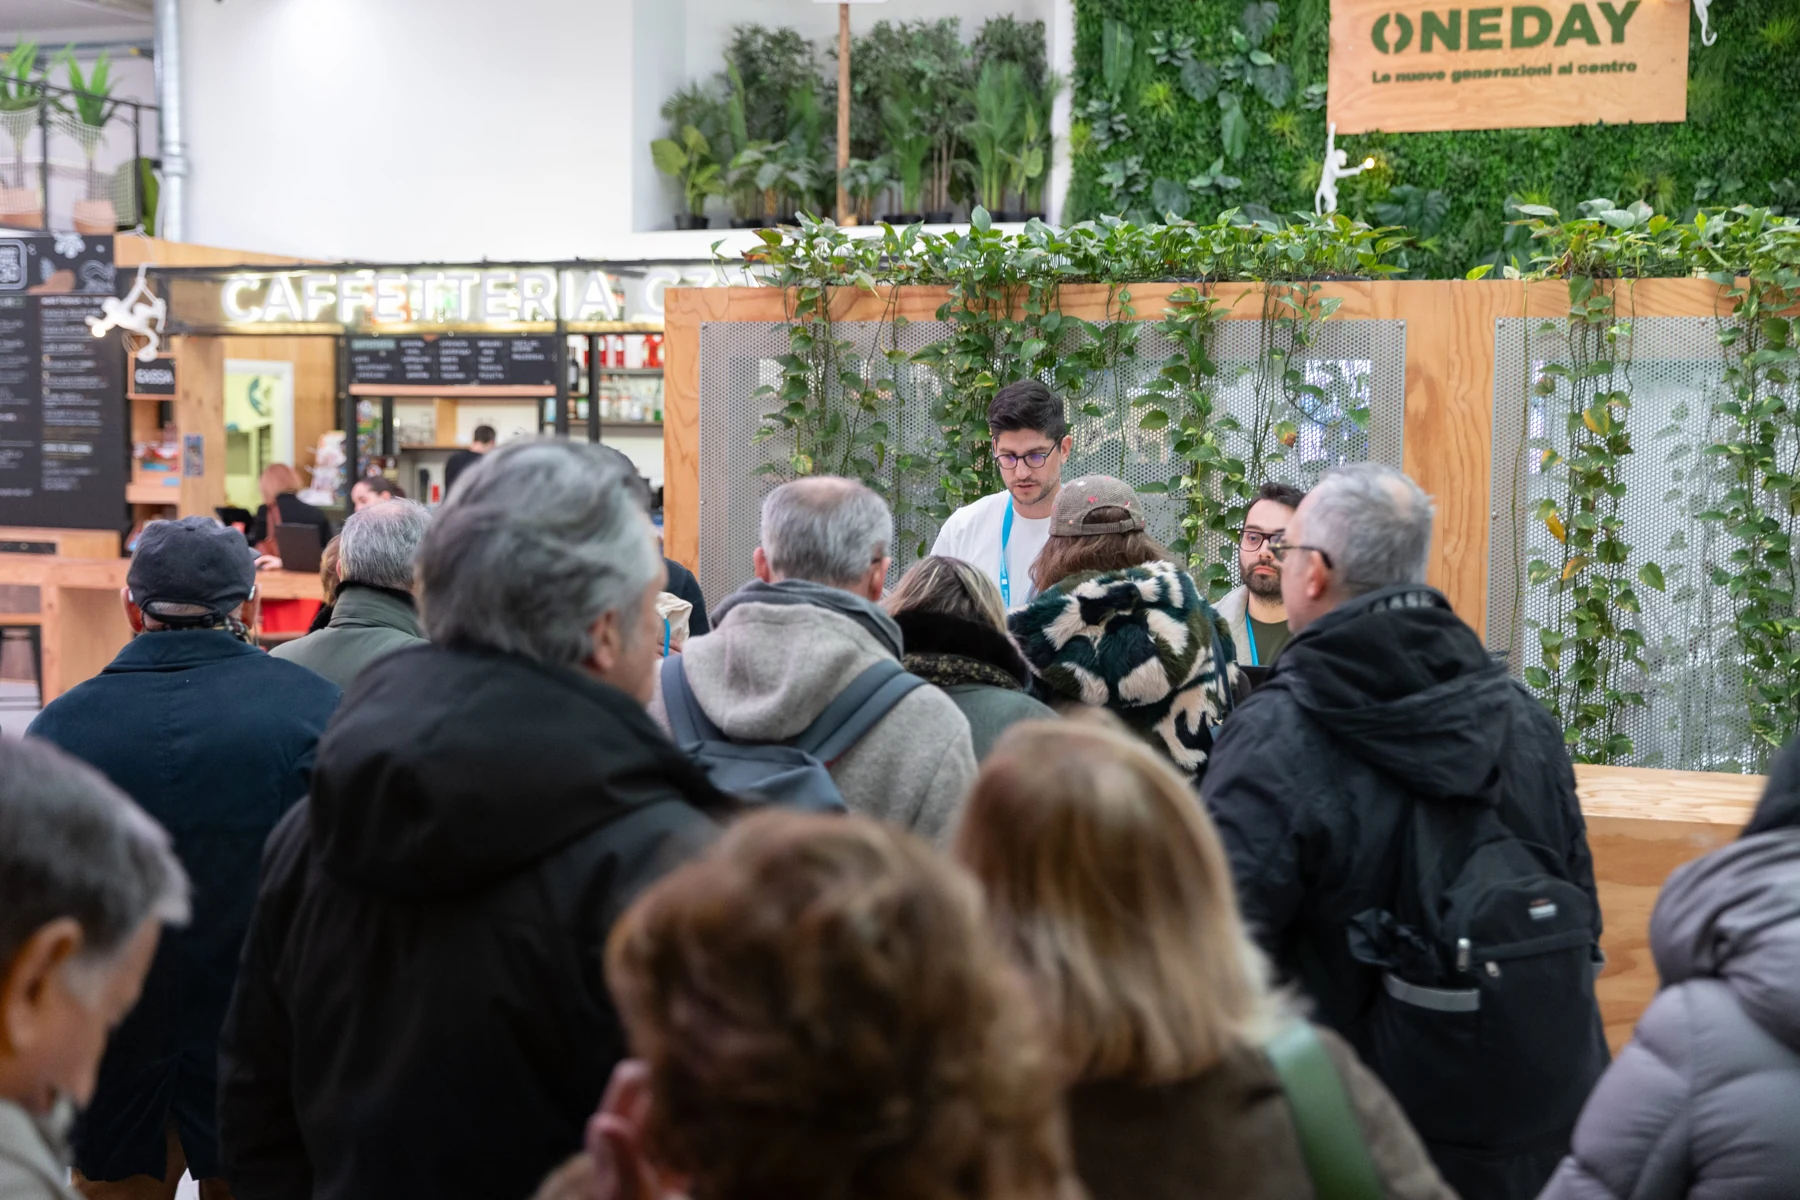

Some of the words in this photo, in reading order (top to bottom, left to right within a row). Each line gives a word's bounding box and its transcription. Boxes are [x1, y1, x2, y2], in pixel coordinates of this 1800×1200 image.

[1371, 0, 1641, 54] ONEDAY
[1372, 70, 1391, 83] Le
[1395, 70, 1446, 82] nuove
[1451, 62, 1552, 83] generazioni
[1557, 62, 1573, 75] al
[1577, 60, 1637, 75] centro
[221, 271, 617, 321] CAFFETTERIA
